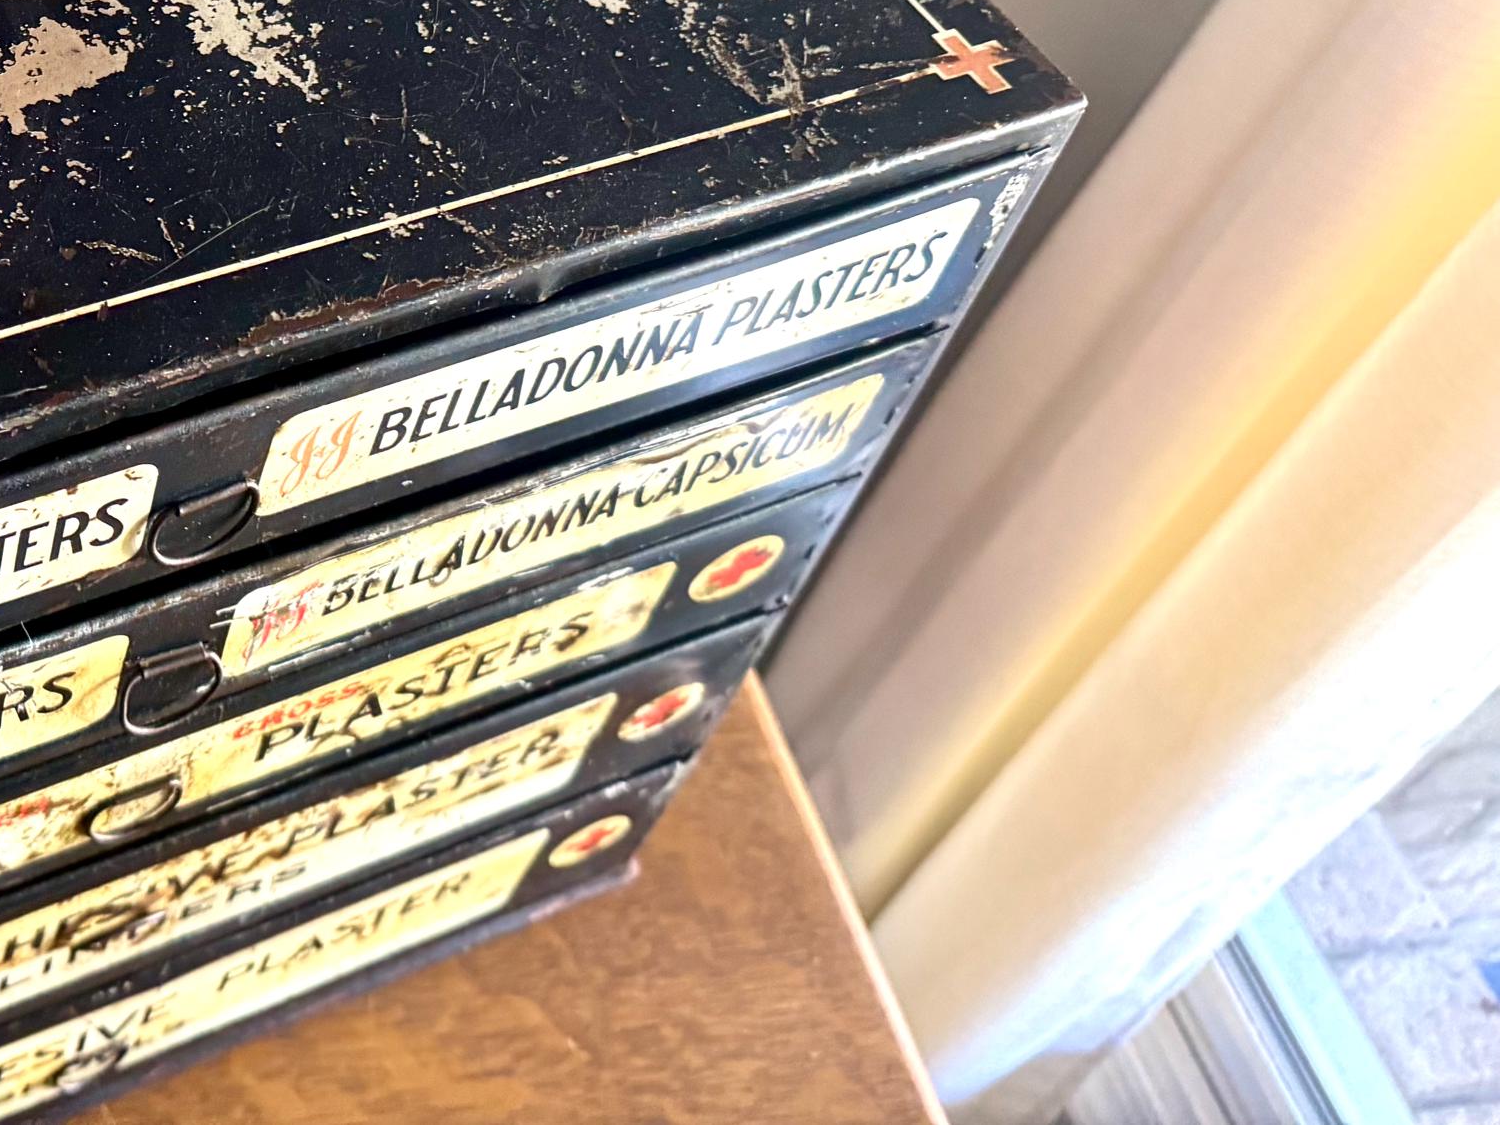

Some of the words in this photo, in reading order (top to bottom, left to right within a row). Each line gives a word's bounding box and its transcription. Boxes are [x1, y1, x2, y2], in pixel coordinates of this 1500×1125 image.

[368, 308, 703, 457] BELLADONNA
[712, 230, 949, 347] PLASTERS
[255, 610, 595, 763] PLASTERS
[217, 870, 474, 994] PLASTER
